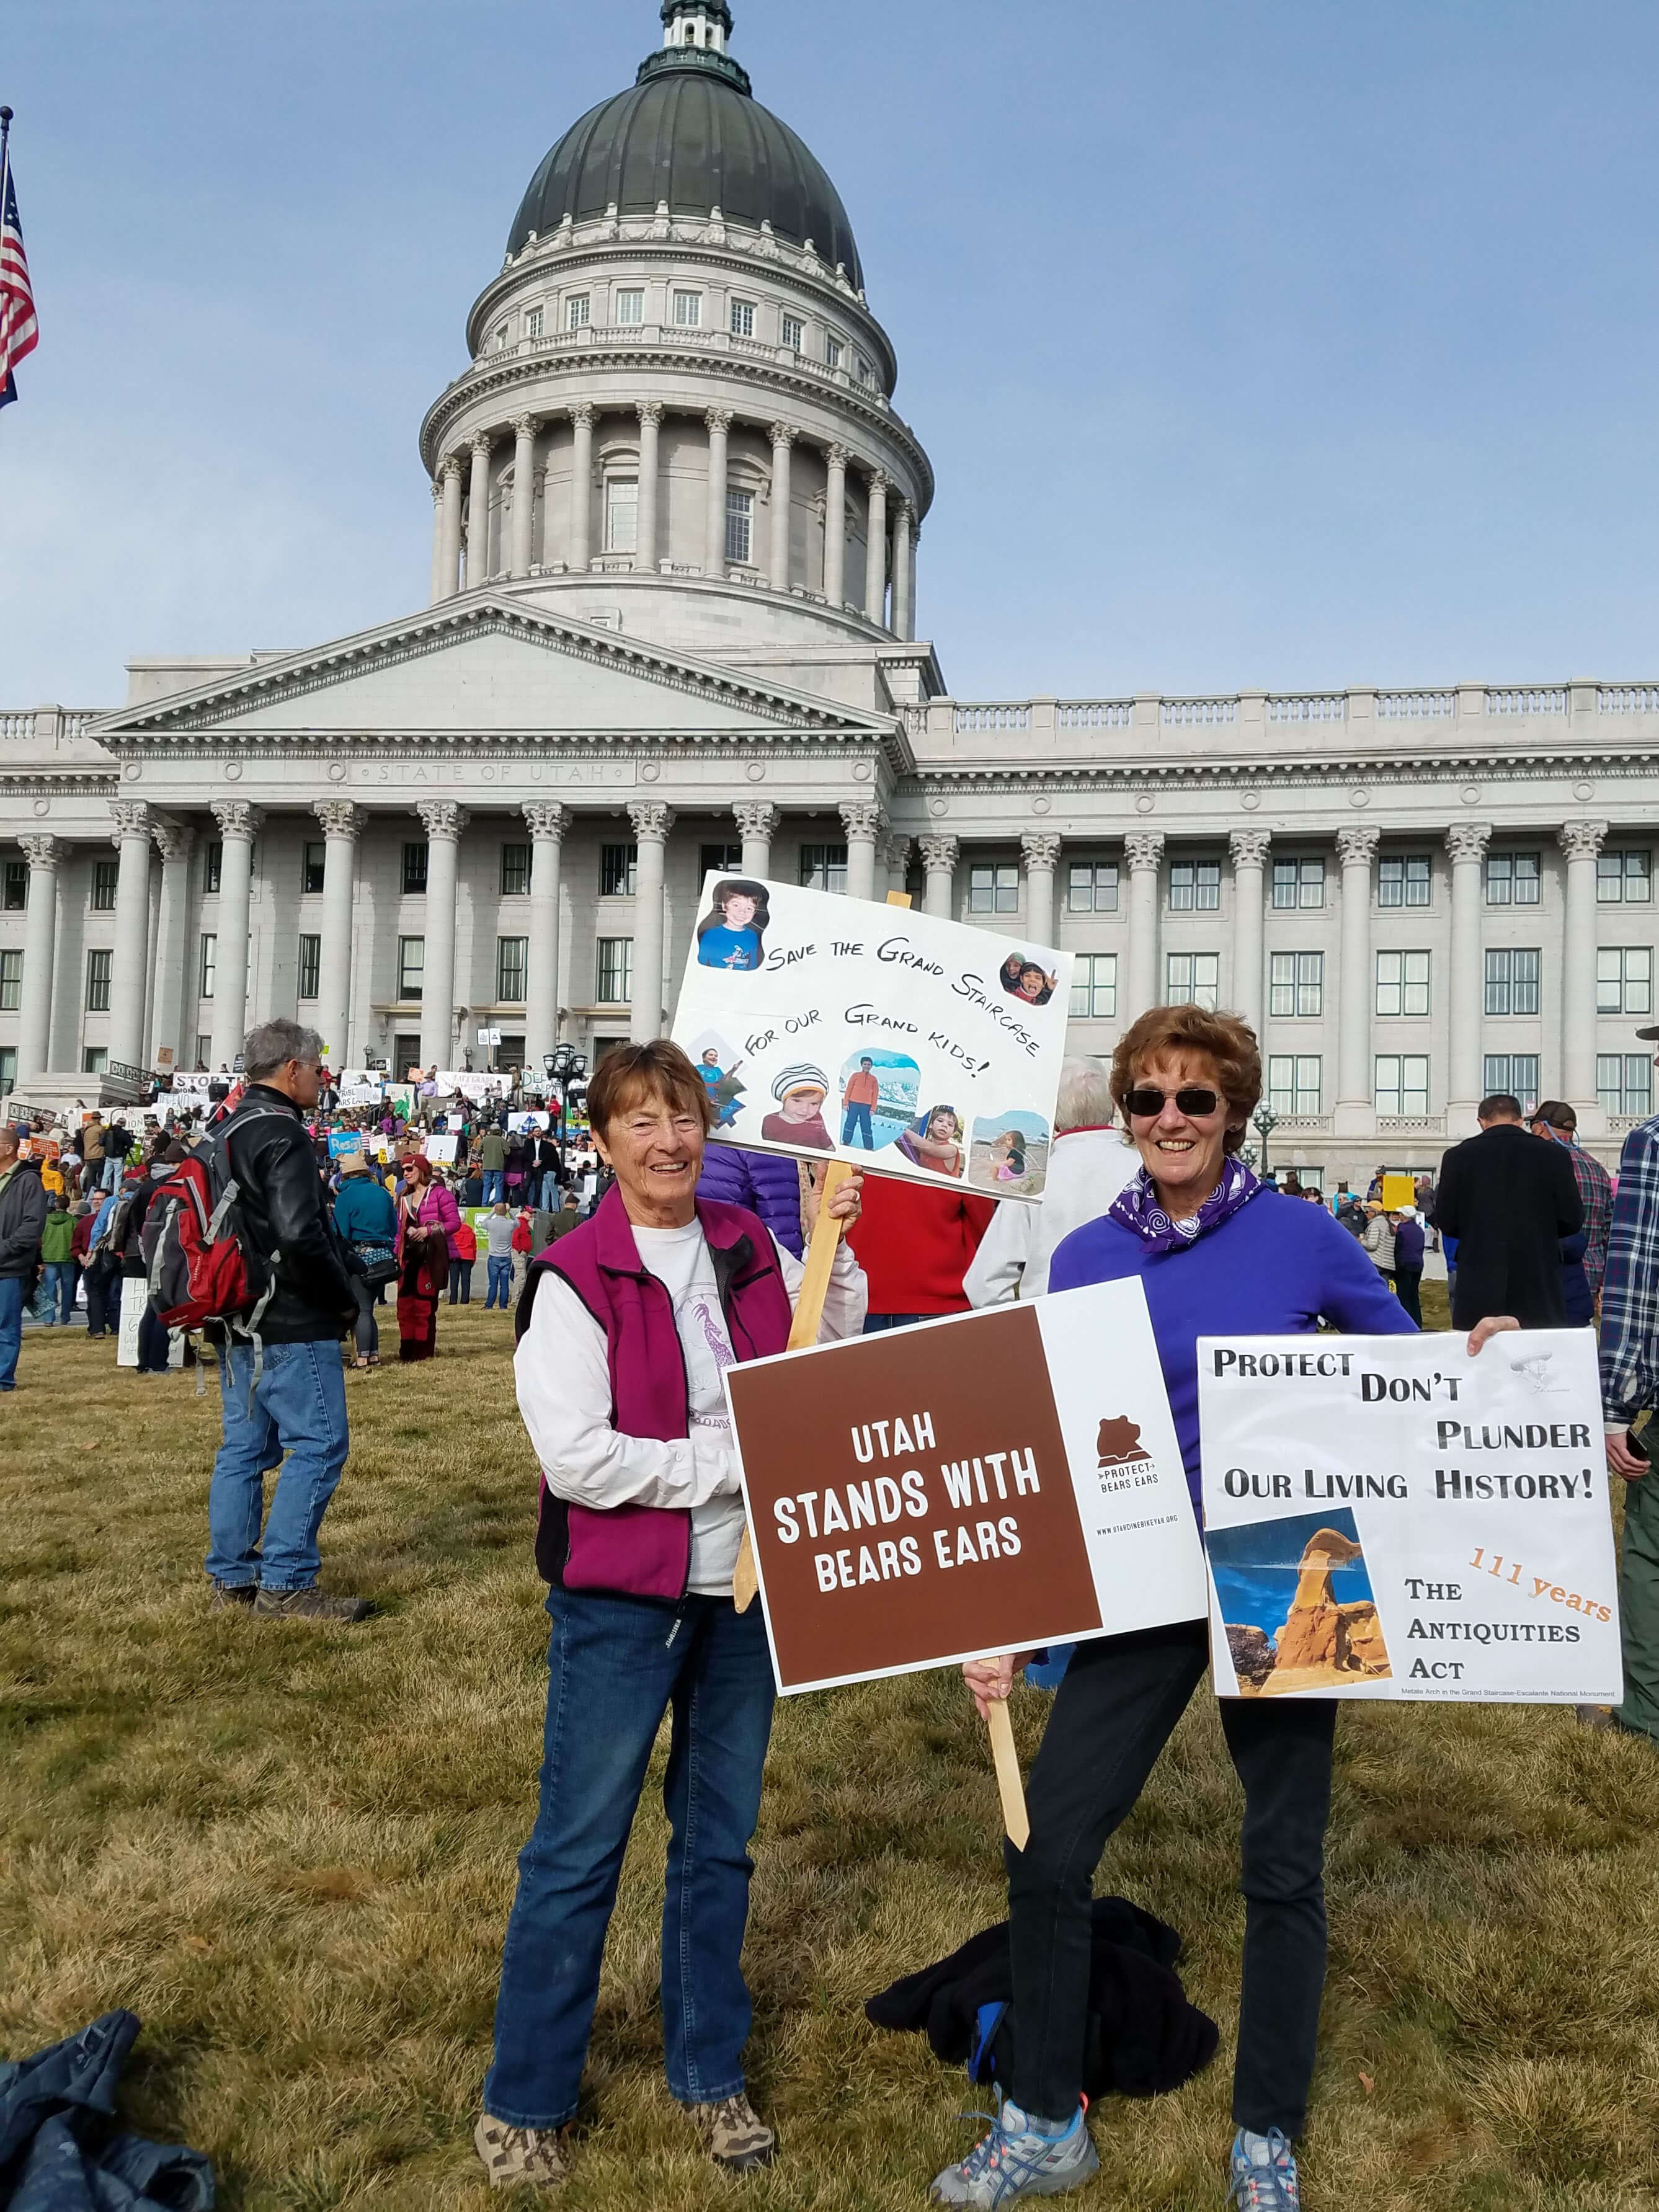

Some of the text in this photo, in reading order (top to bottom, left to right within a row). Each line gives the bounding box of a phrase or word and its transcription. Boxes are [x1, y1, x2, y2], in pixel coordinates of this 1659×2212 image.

[379, 765, 604, 781] STATE OF UTAH
[766, 938, 1039, 1057] SAVE THE GRAND STAIRCASE
[745, 1004, 990, 1079] FOR OUR GRAND KIDS!
[1214, 1350, 1354, 1377] PROTECT
[1361, 1373, 1462, 1401] DON'T
[852, 1412, 935, 1462] UTAH
[1437, 1421, 1591, 1449] PLUNDER
[1101, 1474, 1158, 1493] BEARS EARS
[1105, 1463, 1150, 1480] PROTECT
[1225, 1469, 1592, 1499] OUR LIVING HISTORY!
[774, 1447, 1040, 1545] STANDS WITH
[815, 1517, 1021, 1592] BEARS EARS
[1405, 1579, 1462, 1600] THE
[1469, 1548, 1611, 1622] 111 years
[1407, 1619, 1580, 1644] ANTIQUITIES
[1409, 1658, 1464, 1679] ACT
